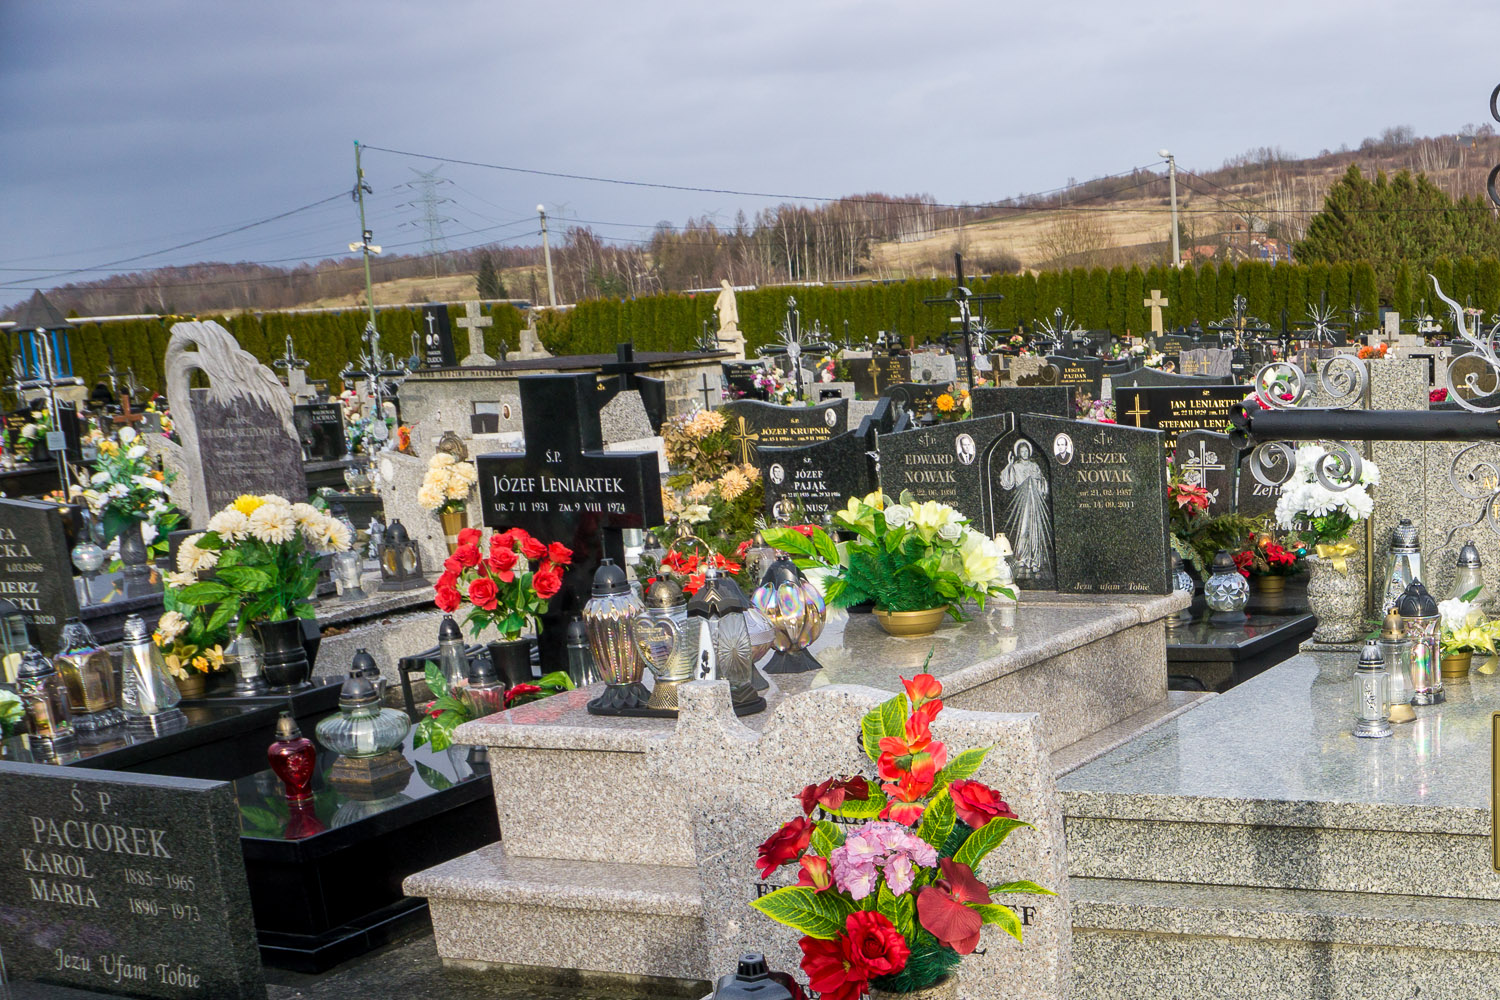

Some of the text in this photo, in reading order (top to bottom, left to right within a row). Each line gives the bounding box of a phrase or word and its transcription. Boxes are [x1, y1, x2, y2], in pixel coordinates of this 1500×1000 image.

[1171, 400, 1186, 409] JAN
[1158, 420, 1200, 428] STEFANIA
[761, 426, 831, 436] JÓZEF KRUPNIK
[546, 449, 562, 463] Ś.P.
[905, 453, 953, 465] EDWARD
[1081, 452, 1127, 464] LESZEK
[795, 468, 824, 479] JÓZEF
[904, 470, 957, 483] NOWAK
[1077, 470, 1132, 483] NOWAK
[493, 474, 625, 496] JÓZEF LENIARTEK
[794, 481, 827, 492] PAJĄK
[510, 503, 625, 512] 7 II 1931 9 VIII 1974
[1099, 583, 1120, 591] ufam
[1128, 582, 1149, 591] Tobie
[31, 816, 172, 859] PACIOREK
[21, 848, 95, 879] KAROL
[28, 878, 101, 908] MARIA
[55, 948, 201, 989] Jezu Ufam Tobie
